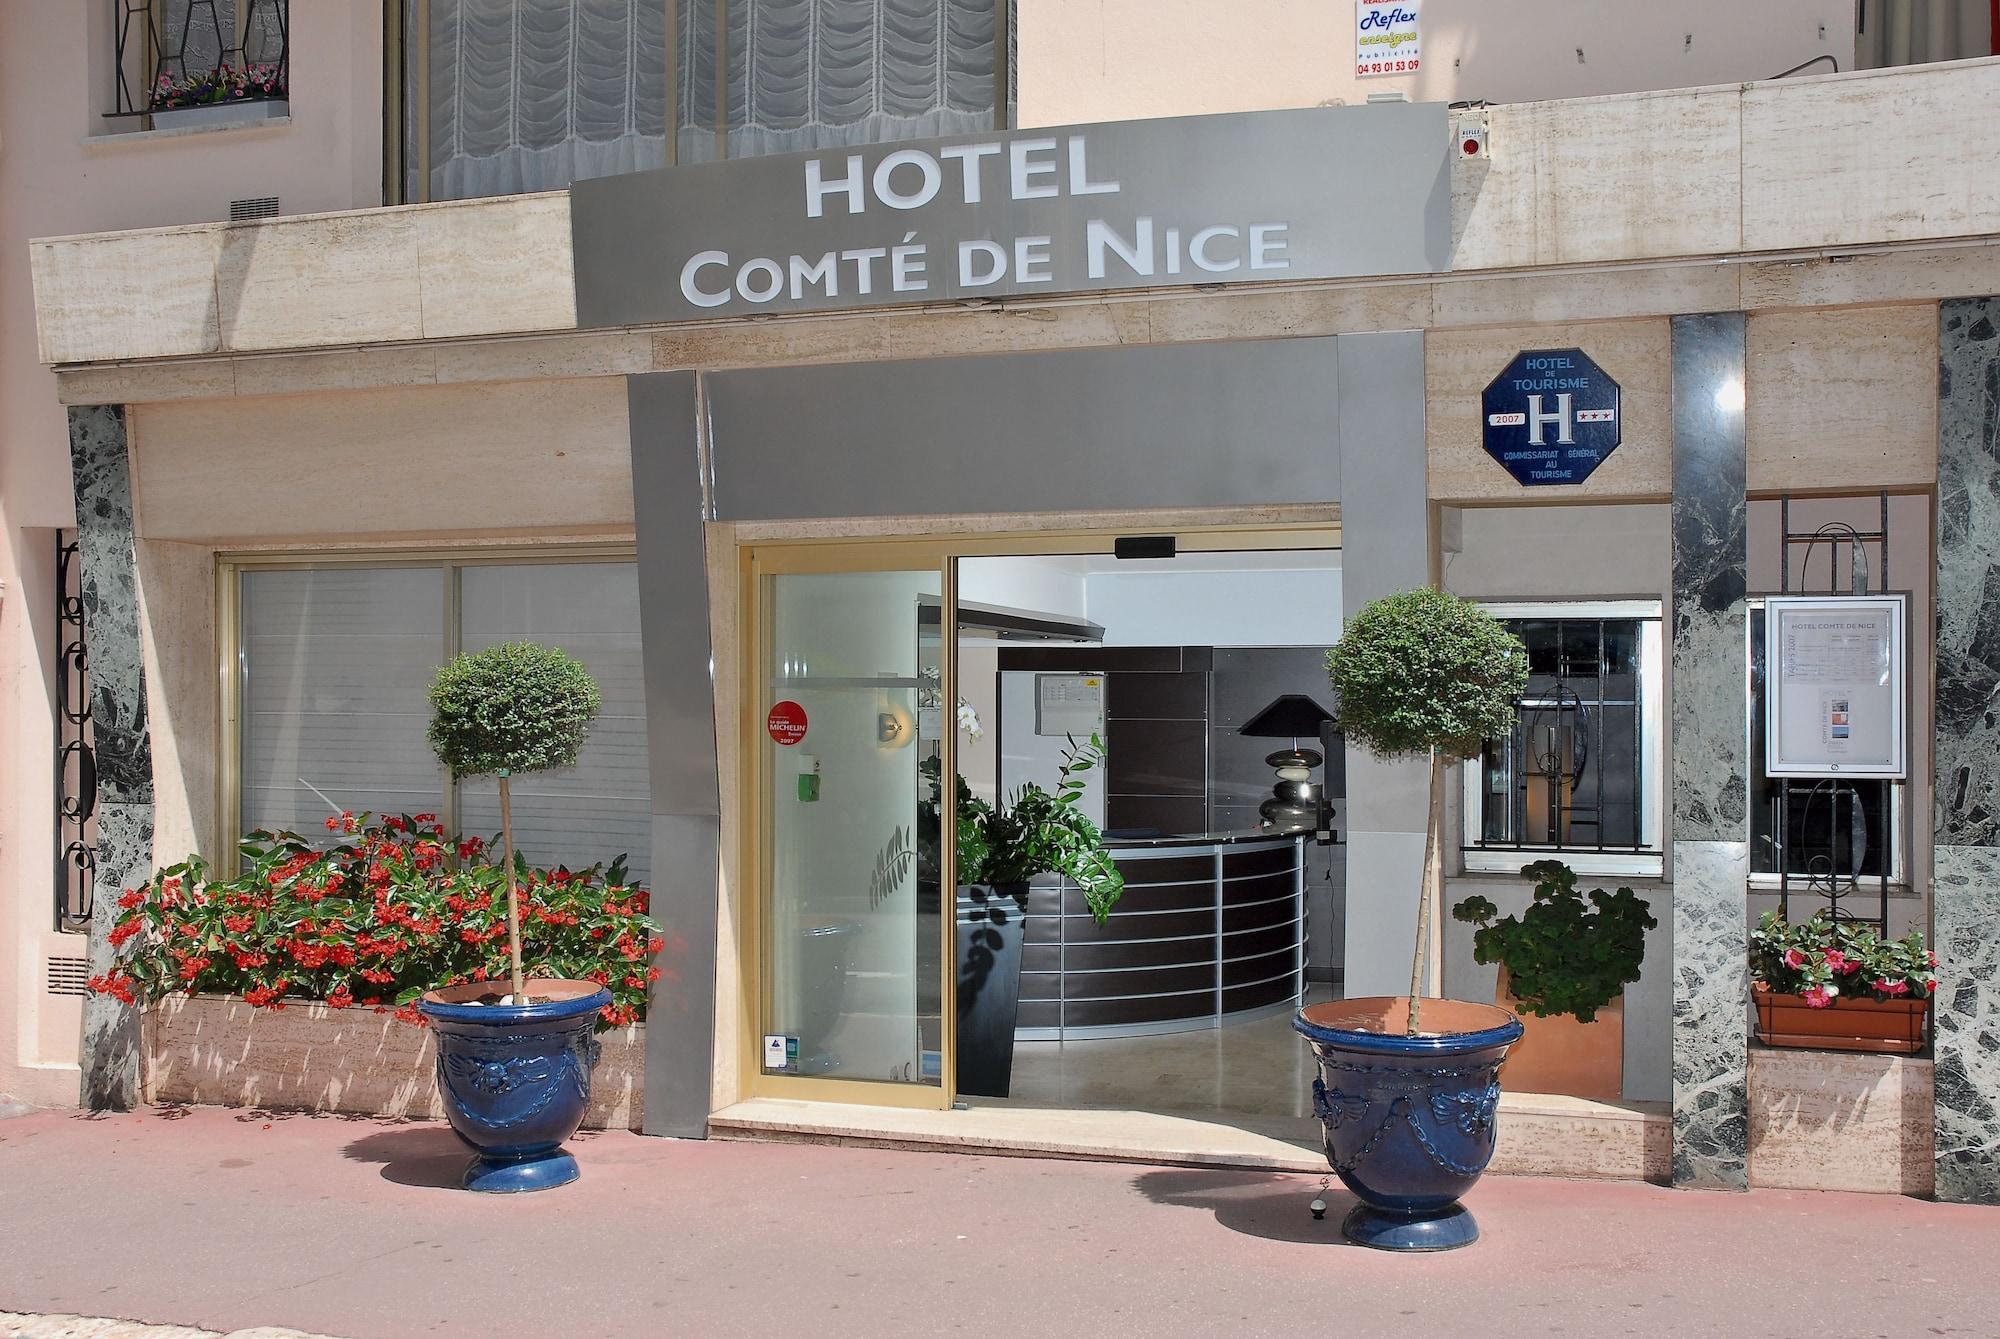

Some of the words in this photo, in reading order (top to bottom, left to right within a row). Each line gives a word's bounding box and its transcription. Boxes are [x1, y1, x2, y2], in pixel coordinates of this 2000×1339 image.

[1360, 8, 1416, 30] Reflex
[1359, 32, 1417, 48] enseigne
[1357, 64, 1369, 74] 04
[1371, 63, 1382, 72] 93
[1384, 62, 1393, 72] 01
[1395, 61, 1405, 71] 53
[1408, 59, 1419, 70] 09
[804, 135, 1121, 218] HOTEL
[957, 235, 1053, 288] DE
[1526, 358, 1575, 370] HOTEL
[1513, 378, 1589, 391] TOURISME
[1496, 415, 1519, 424] 2007
[1527, 393, 1576, 446] H
[1504, 450, 1559, 460] COMMISSARIAT
[1545, 460, 1557, 469] AU
[1530, 469, 1572, 479] TOURISME
